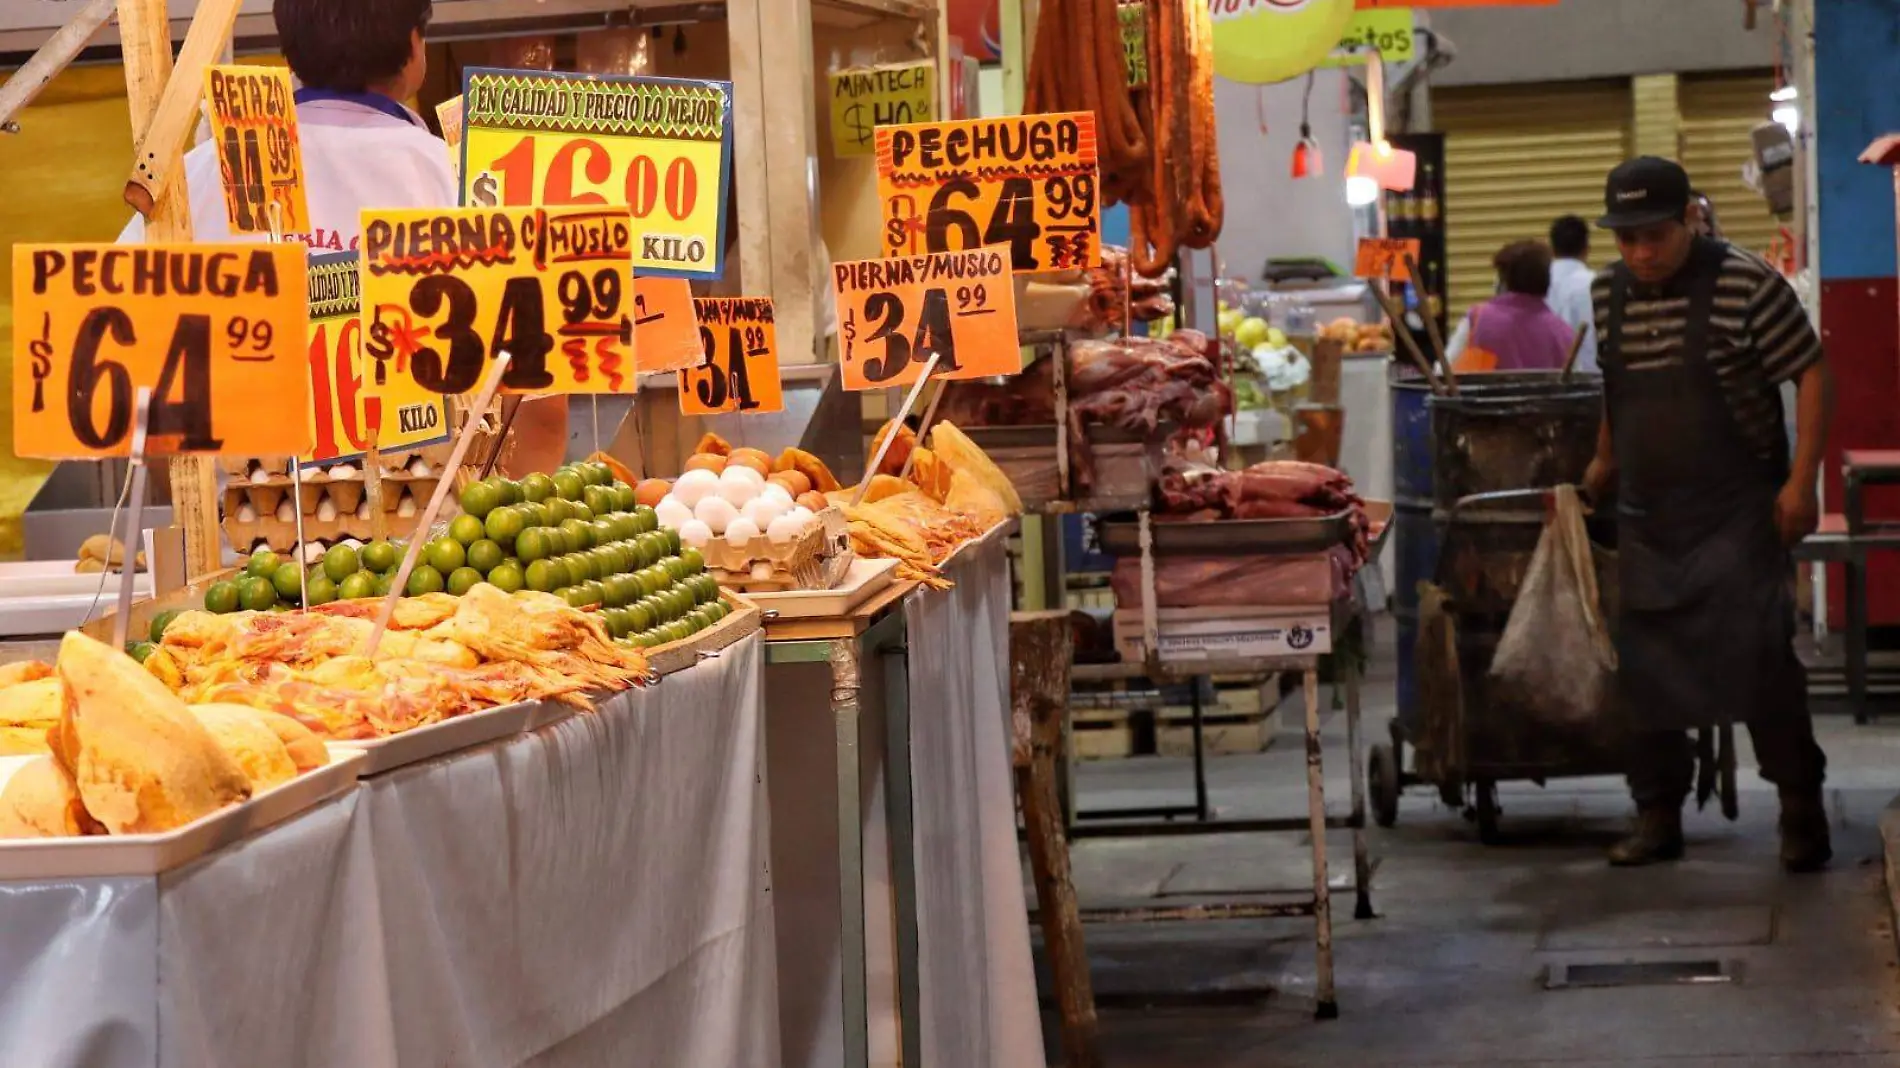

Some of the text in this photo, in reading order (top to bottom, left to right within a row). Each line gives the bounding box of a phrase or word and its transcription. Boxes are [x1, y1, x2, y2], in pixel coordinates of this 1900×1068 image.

[211, 69, 287, 119] RETAZO
[836, 67, 925, 98] MANTECA
[477, 86, 717, 126] EN CALIDAD Y PRECIO LO MEJOR
[891, 119, 1079, 169] PECHUGA
[367, 213, 516, 262] PIERNA
[642, 235, 705, 263] KILO
[32, 250, 279, 298] PECHUGA
[835, 260, 914, 293] PIERNA
[558, 267, 622, 324] 99
[956, 283, 987, 309] 99
[226, 316, 273, 352] 99
[399, 405, 438, 434] KILO
